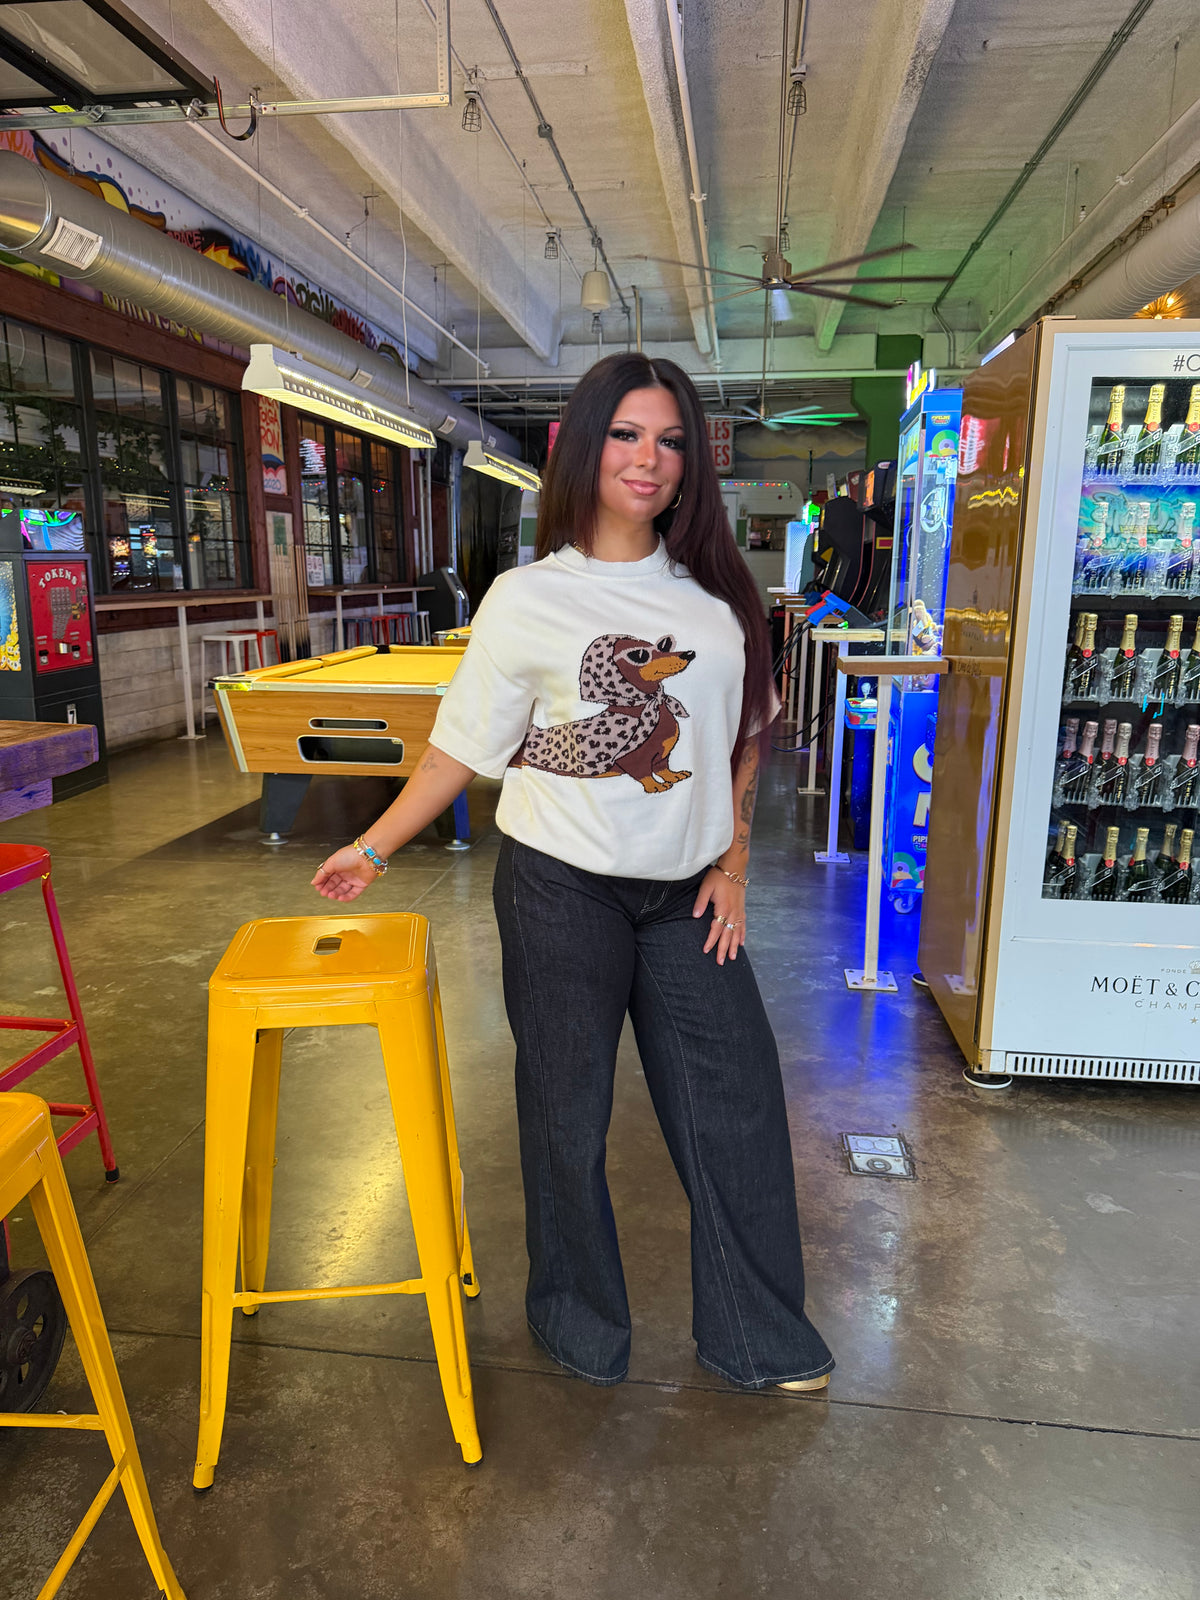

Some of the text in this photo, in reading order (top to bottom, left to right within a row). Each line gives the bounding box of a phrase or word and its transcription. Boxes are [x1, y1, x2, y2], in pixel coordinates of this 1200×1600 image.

[38, 568, 78, 589] TOKENS
[1091, 975, 1161, 995] MOËT
[1165, 982, 1178, 997] &
